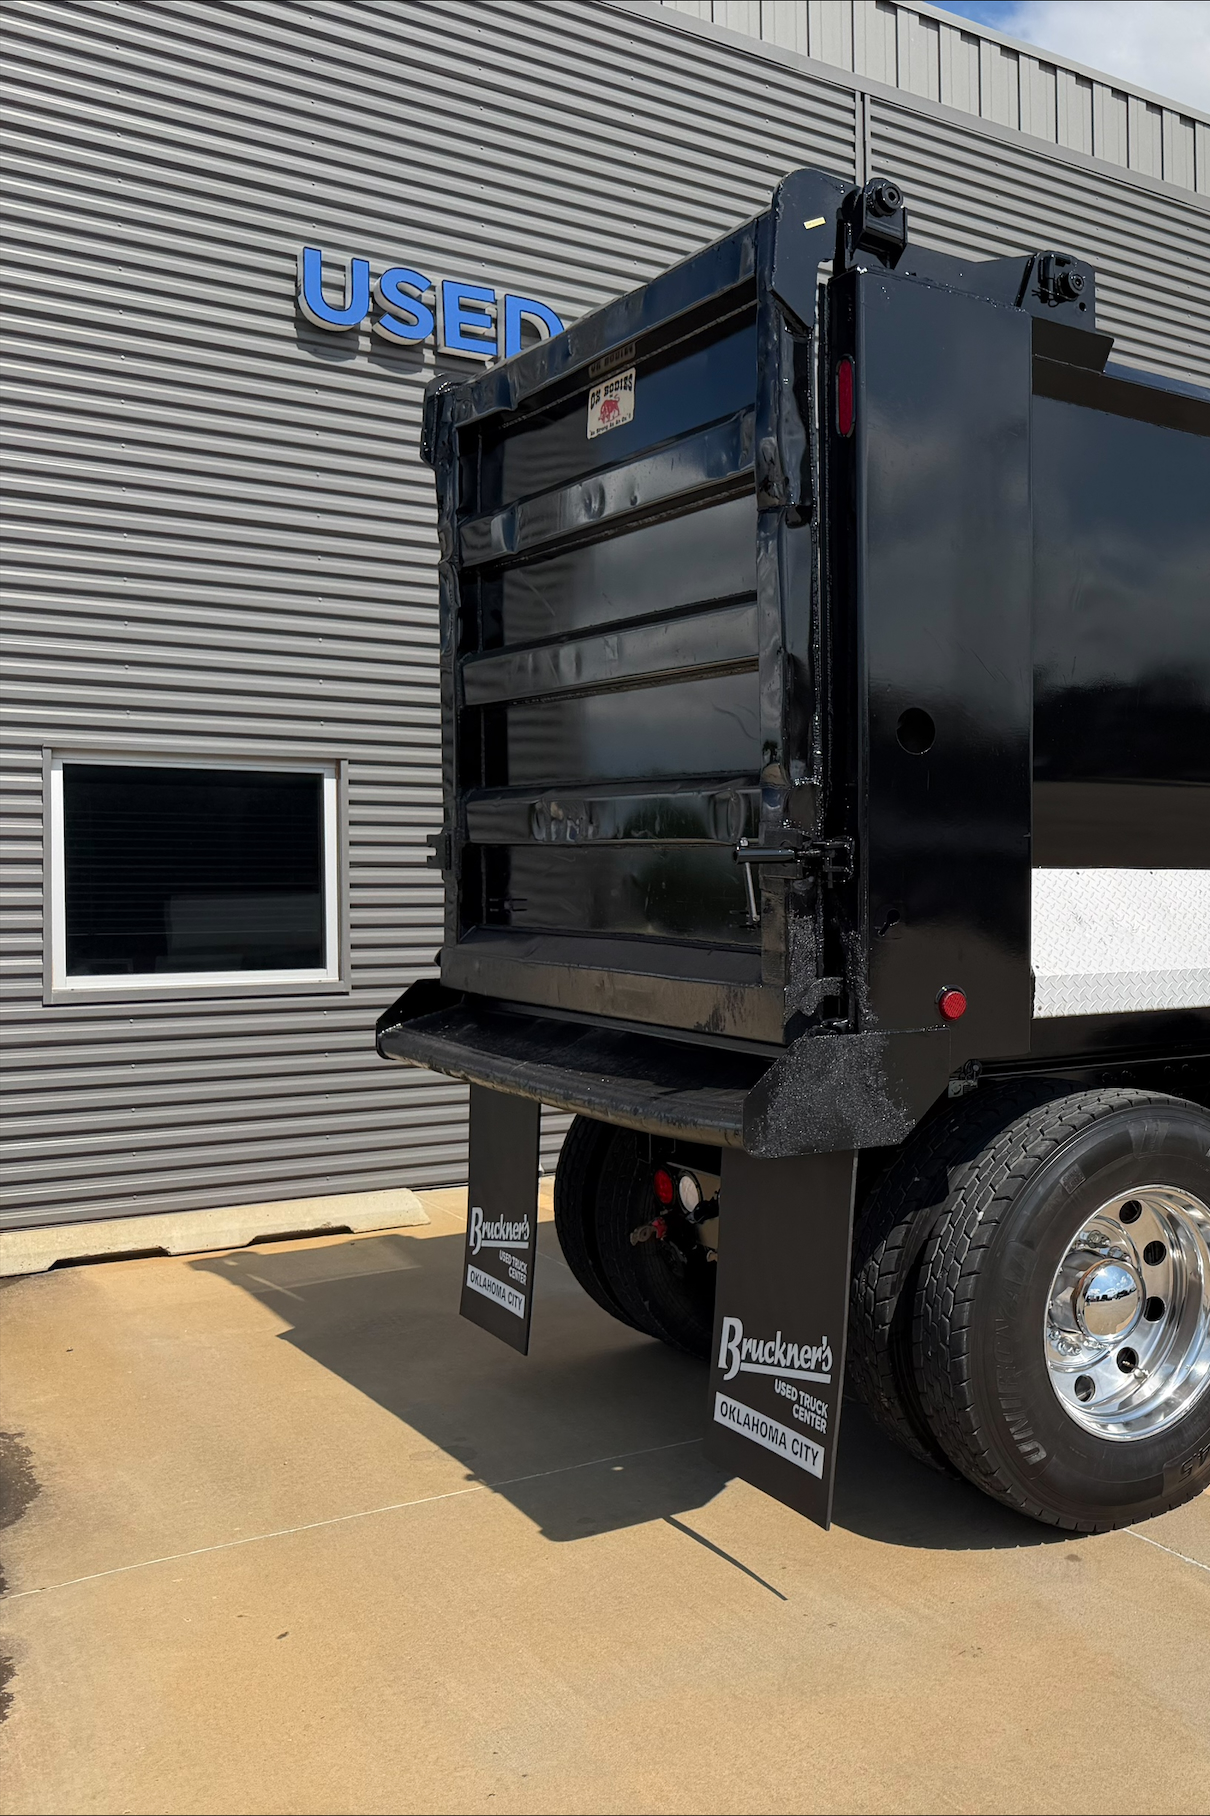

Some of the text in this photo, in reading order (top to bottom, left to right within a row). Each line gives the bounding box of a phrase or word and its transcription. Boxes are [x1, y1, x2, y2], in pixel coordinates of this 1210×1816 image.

[299, 246, 564, 359] USED
[603, 373, 633, 397] BODIES
[469, 1206, 530, 1256] Bruckner's
[499, 1250, 528, 1274] USED TRUCK
[508, 1266, 527, 1286] CENTER
[470, 1270, 523, 1311] OKLAHOMA CITY
[717, 1316, 833, 1381] Bruckner's
[774, 1379, 828, 1419] USED TRUCK
[792, 1404, 827, 1434] CENTER
[720, 1401, 819, 1467] OKLAHOMA CITY
